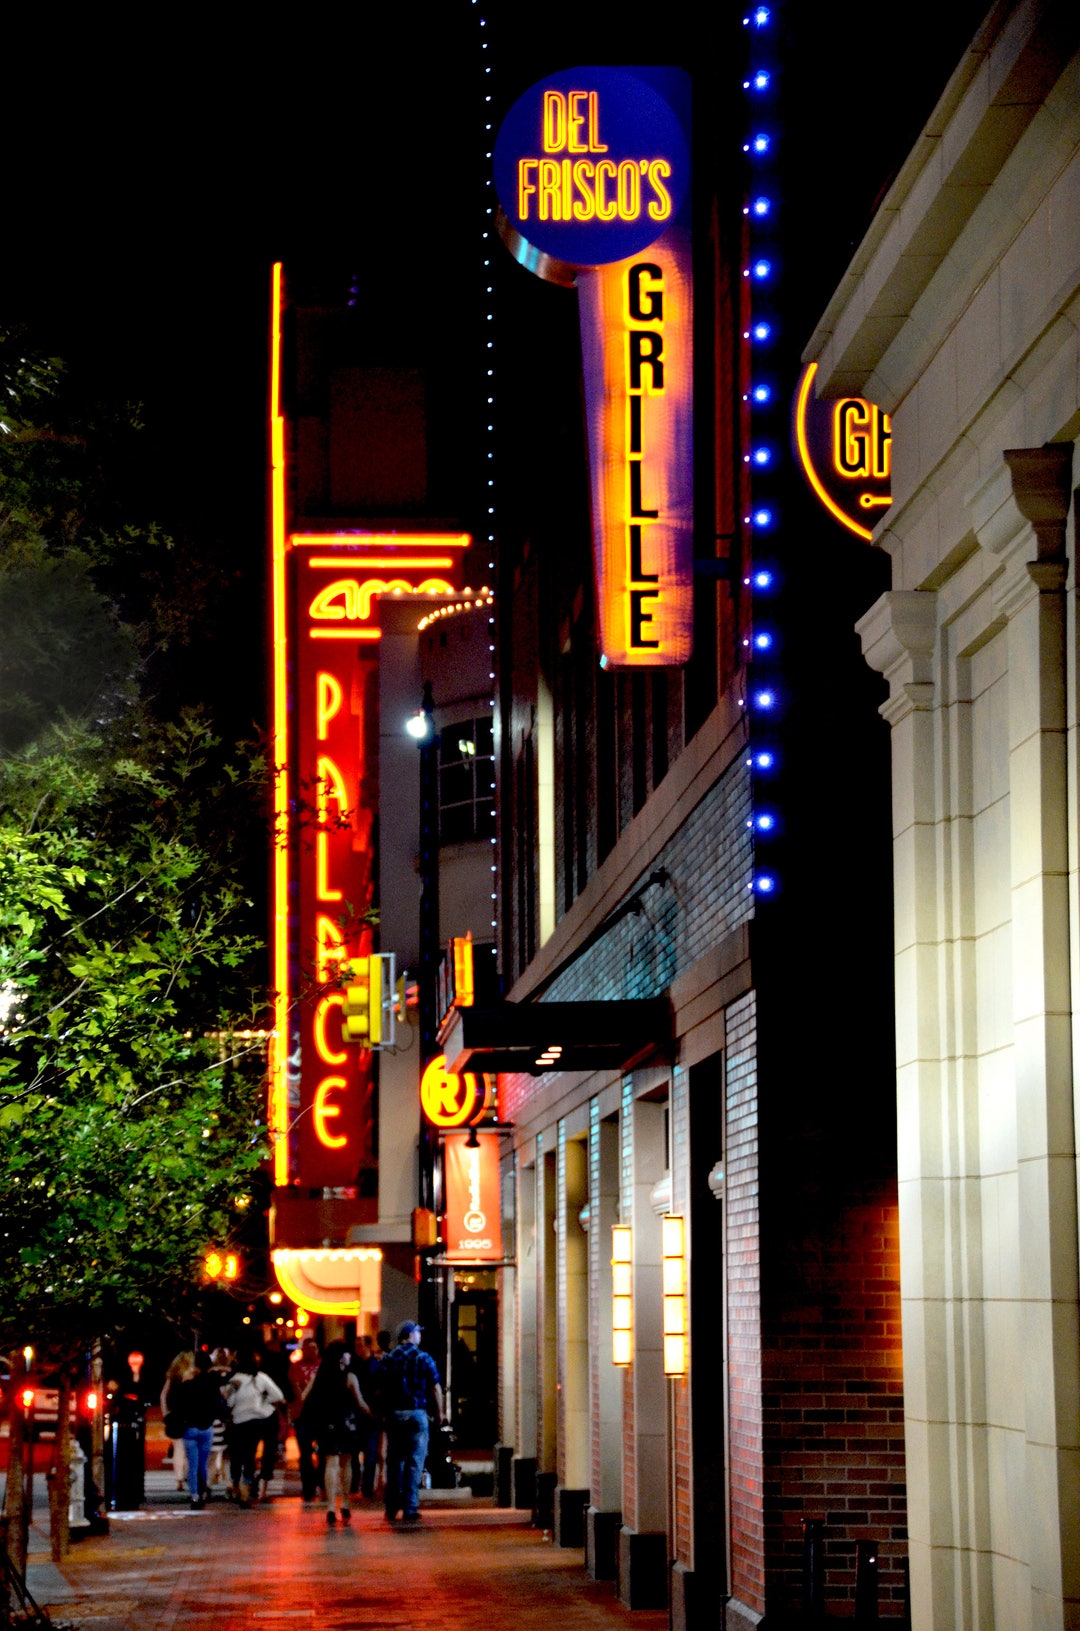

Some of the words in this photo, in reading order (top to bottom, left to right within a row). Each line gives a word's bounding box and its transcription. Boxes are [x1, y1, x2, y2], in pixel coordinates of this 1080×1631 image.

[518, 159, 672, 221] FRISCO'S
[543, 91, 608, 153] DEL
[628, 262, 664, 649] GRILLE
[312, 670, 349, 1149] PALACE
